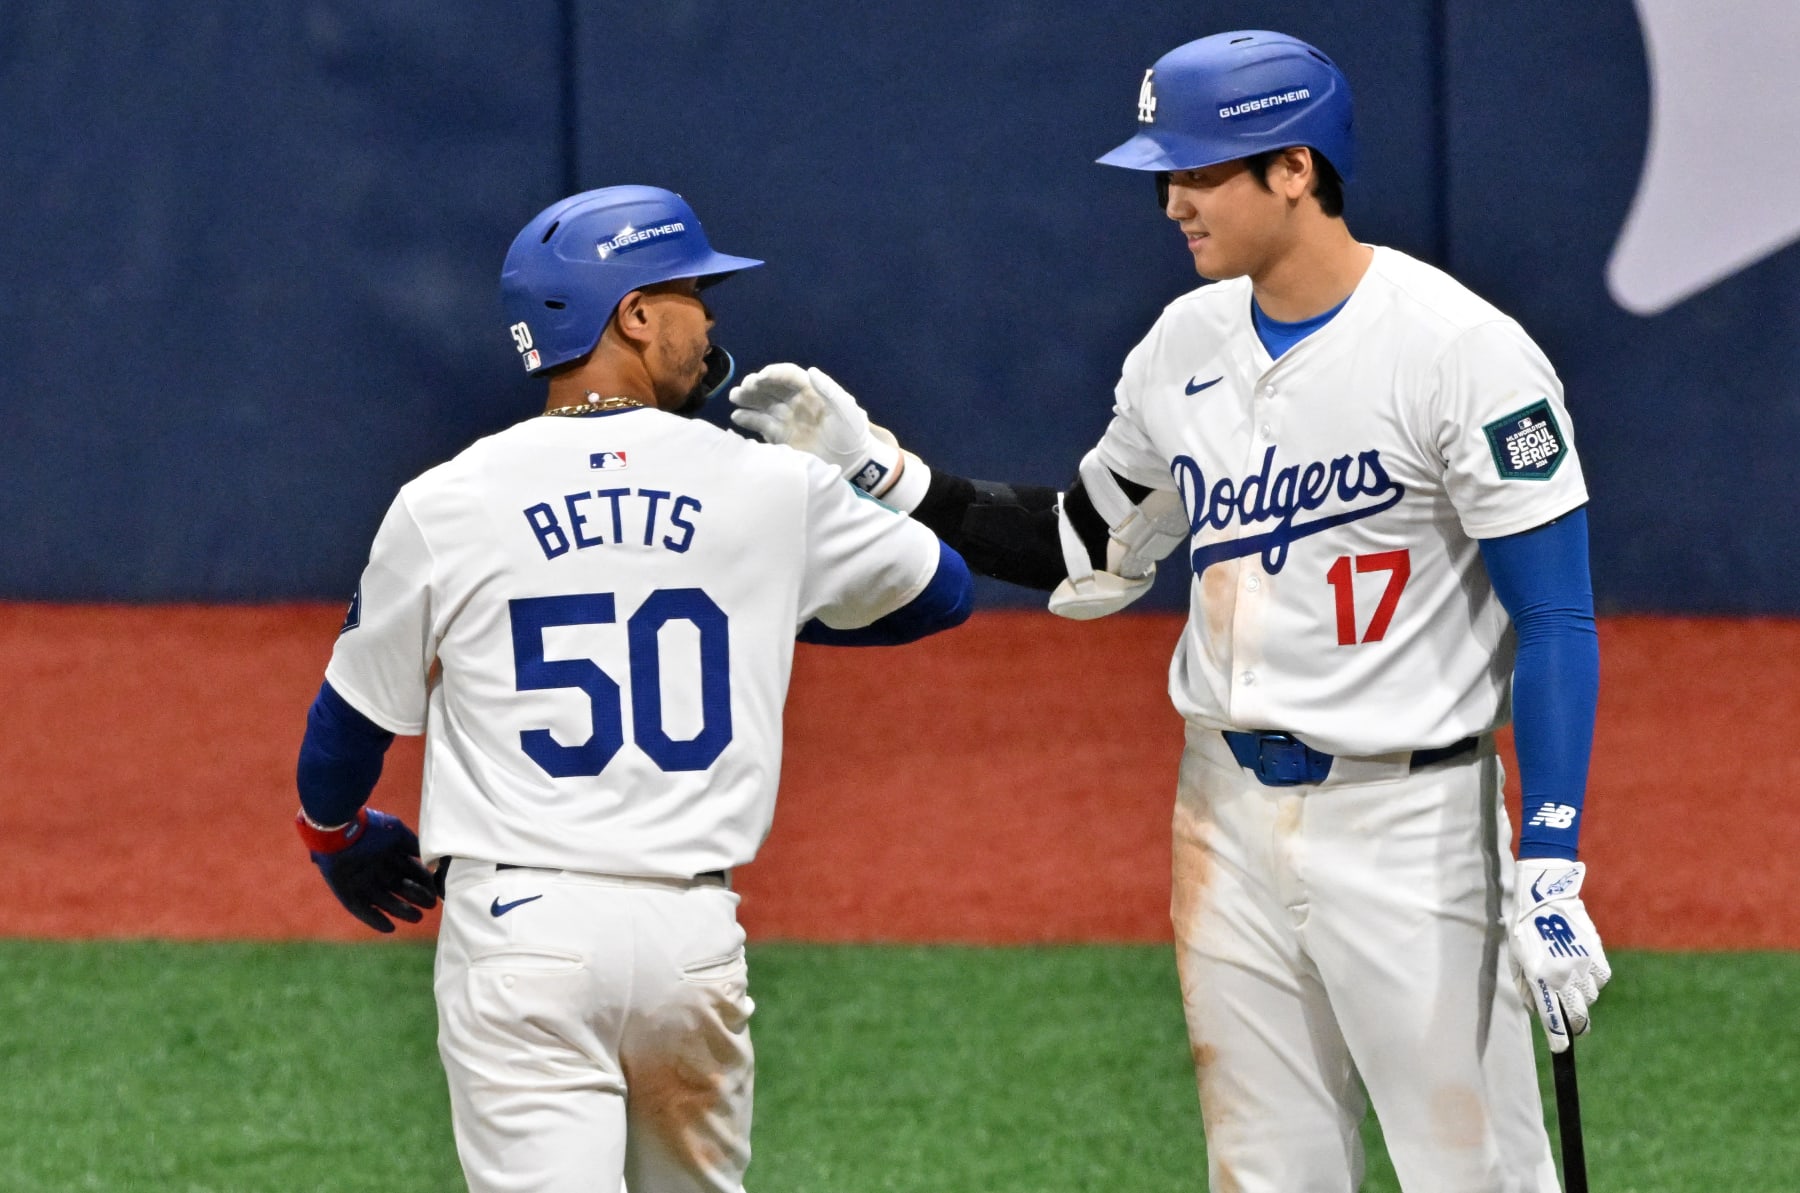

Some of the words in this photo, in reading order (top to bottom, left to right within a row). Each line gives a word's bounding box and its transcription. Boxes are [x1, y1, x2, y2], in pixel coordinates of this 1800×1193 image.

[1138, 68, 1157, 123] LA
[1219, 88, 1310, 119] GUGGENHEIM
[597, 222, 685, 254] GUGGENHEIM
[510, 321, 533, 353] 50
[1507, 427, 1554, 456] SEOUL
[1511, 438, 1559, 470] SERIES
[523, 487, 703, 561] BETTS
[1171, 444, 1405, 580] Dodgers
[1326, 548, 1411, 646] 17
[508, 587, 733, 778] 50
